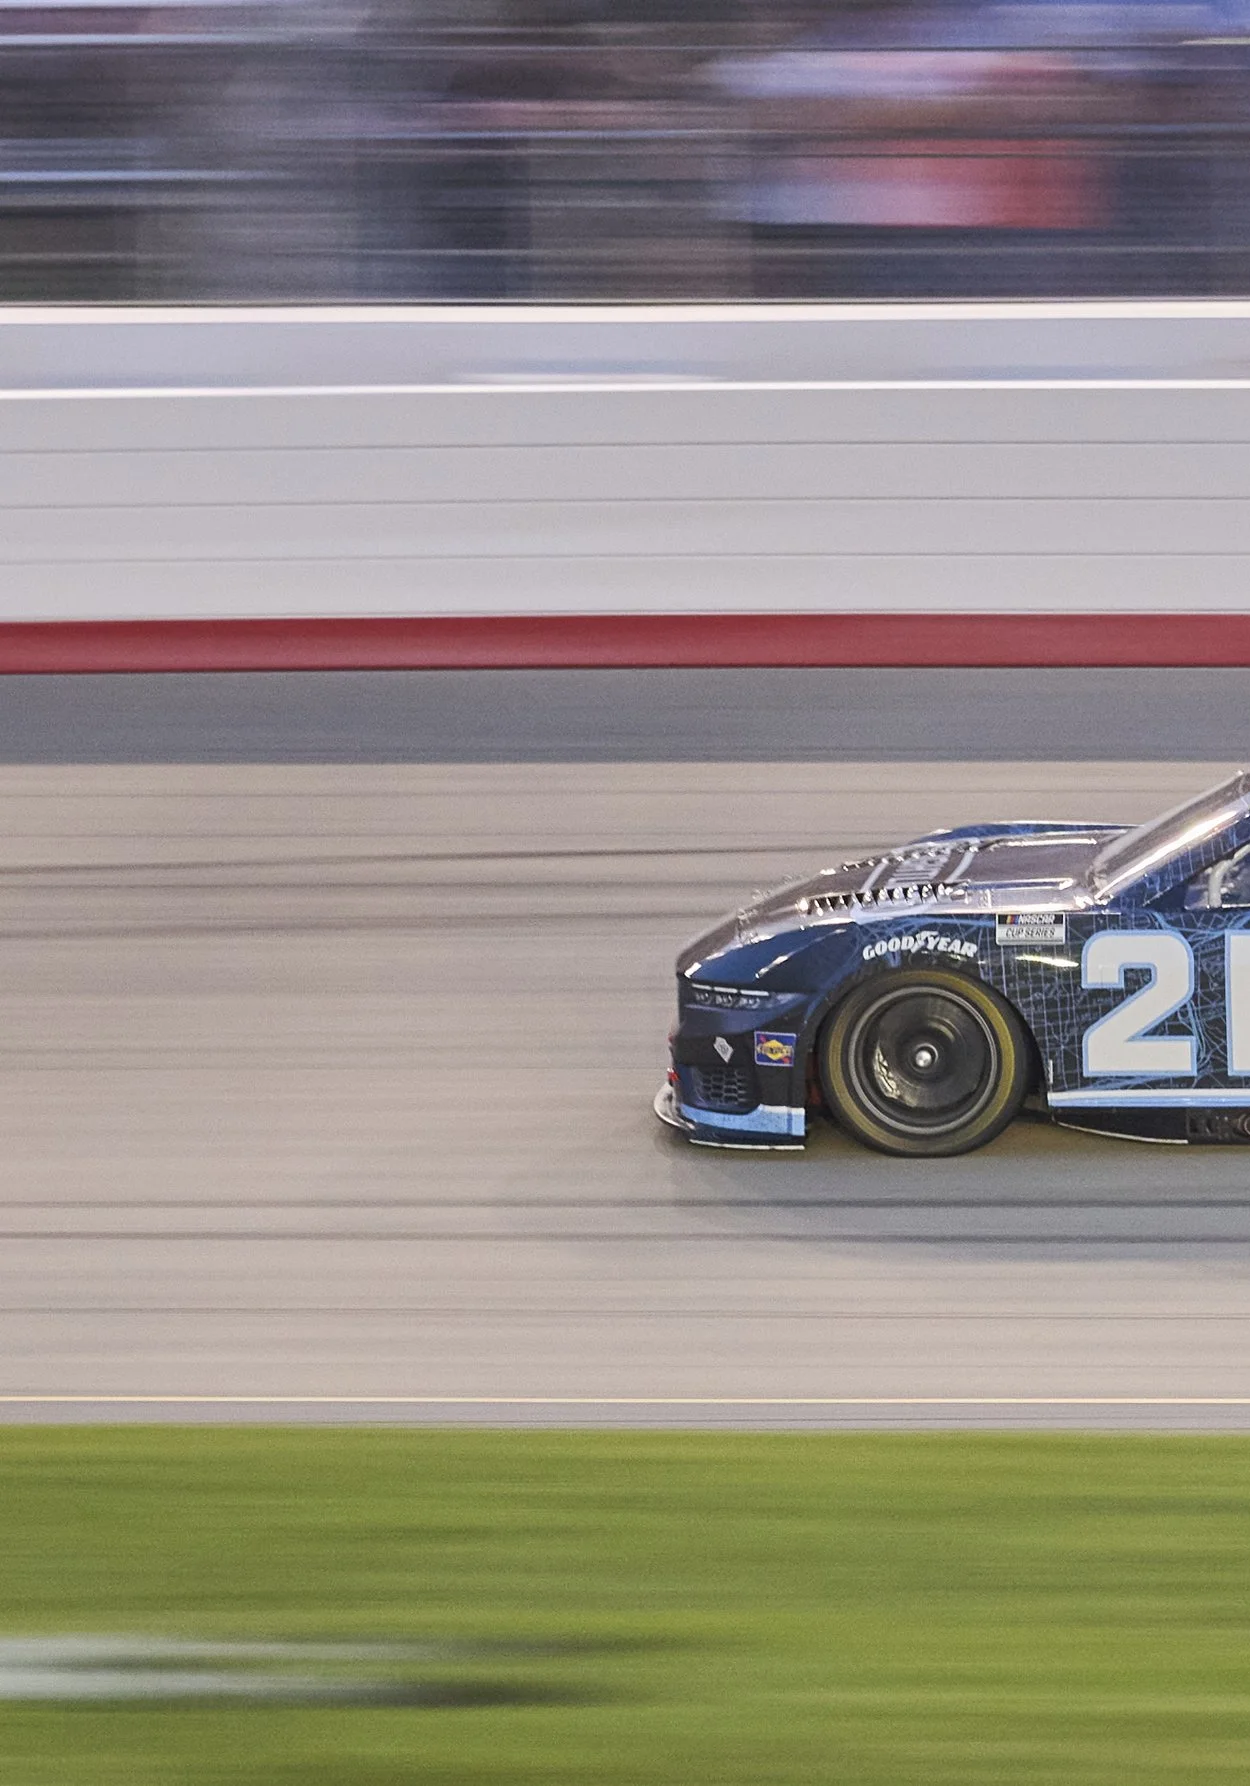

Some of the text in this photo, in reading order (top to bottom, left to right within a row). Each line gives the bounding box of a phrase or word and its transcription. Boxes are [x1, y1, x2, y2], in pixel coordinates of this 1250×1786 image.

[1017, 914, 1055, 925] NASCAR
[1005, 927, 1055, 938] CUP SERIES
[862, 930, 978, 961] GOODYEAR
